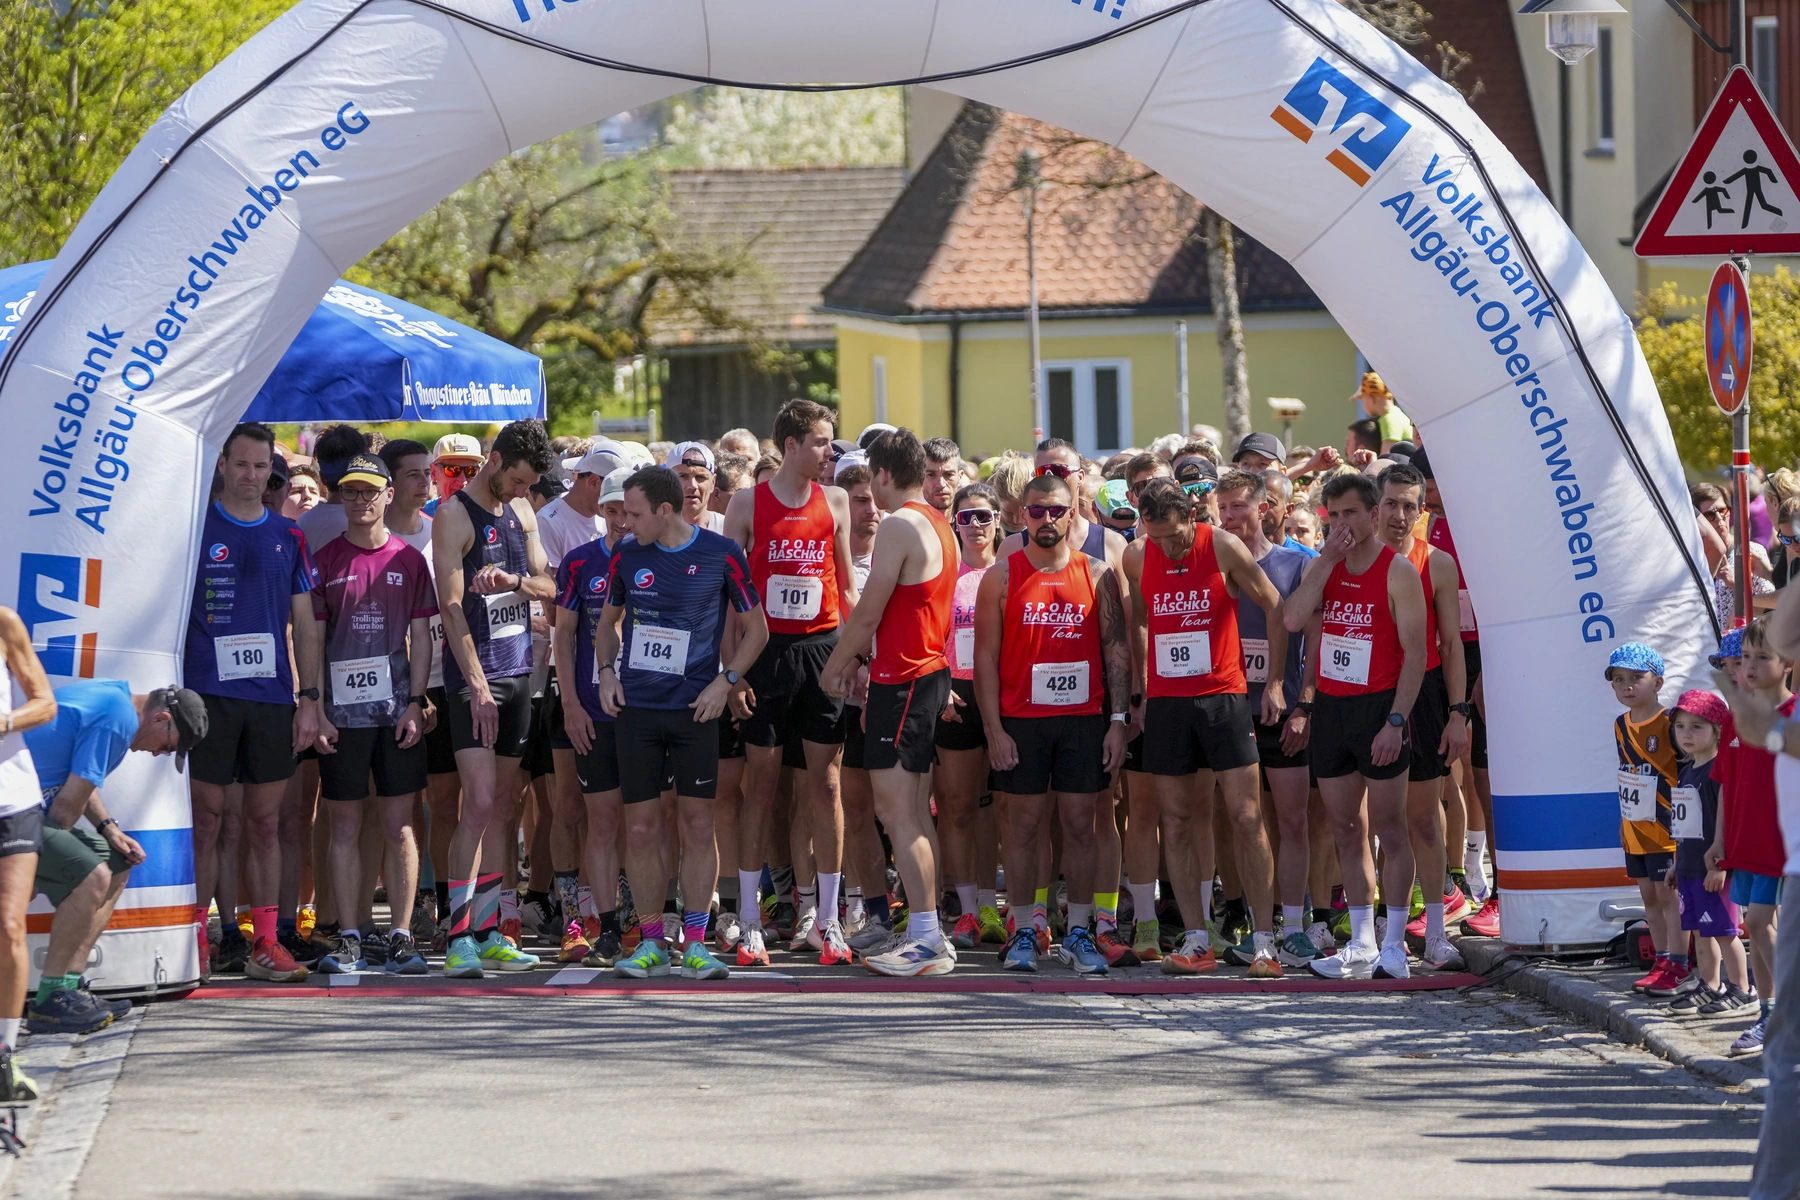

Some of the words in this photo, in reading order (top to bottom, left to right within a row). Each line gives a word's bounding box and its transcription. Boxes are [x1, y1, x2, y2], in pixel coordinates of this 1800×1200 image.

[1422, 153, 1555, 329] Volksbank
[76, 150, 320, 535] Allgäu-Oberschwaben
[321, 101, 371, 151] eG
[29, 324, 124, 517] Volksbank
[1380, 190, 1597, 580] Allgäu-Oberschwaben
[1579, 591, 1615, 643] eG
[769, 539, 826, 550] SPORT
[768, 549, 825, 560] HASCHKO
[796, 562, 824, 575] Team
[781, 589, 808, 605] 101
[1154, 589, 1210, 604] SPORT
[490, 602, 527, 625] 20913
[1025, 601, 1085, 613] SPORT
[1154, 600, 1210, 613] HASCHKO
[1324, 600, 1374, 613] SPORT
[1023, 612, 1084, 623] HASCHKO
[1181, 614, 1212, 627] Team
[1323, 610, 1372, 624] HASCHKO
[1051, 626, 1082, 639] Team
[1343, 627, 1373, 640] Team
[232, 649, 263, 665] 180
[644, 641, 672, 660] 184
[1170, 646, 1190, 662] 98
[1333, 649, 1350, 667] 96
[1245, 654, 1265, 670] 70
[346, 671, 378, 688] 426
[1046, 675, 1077, 690] 428
